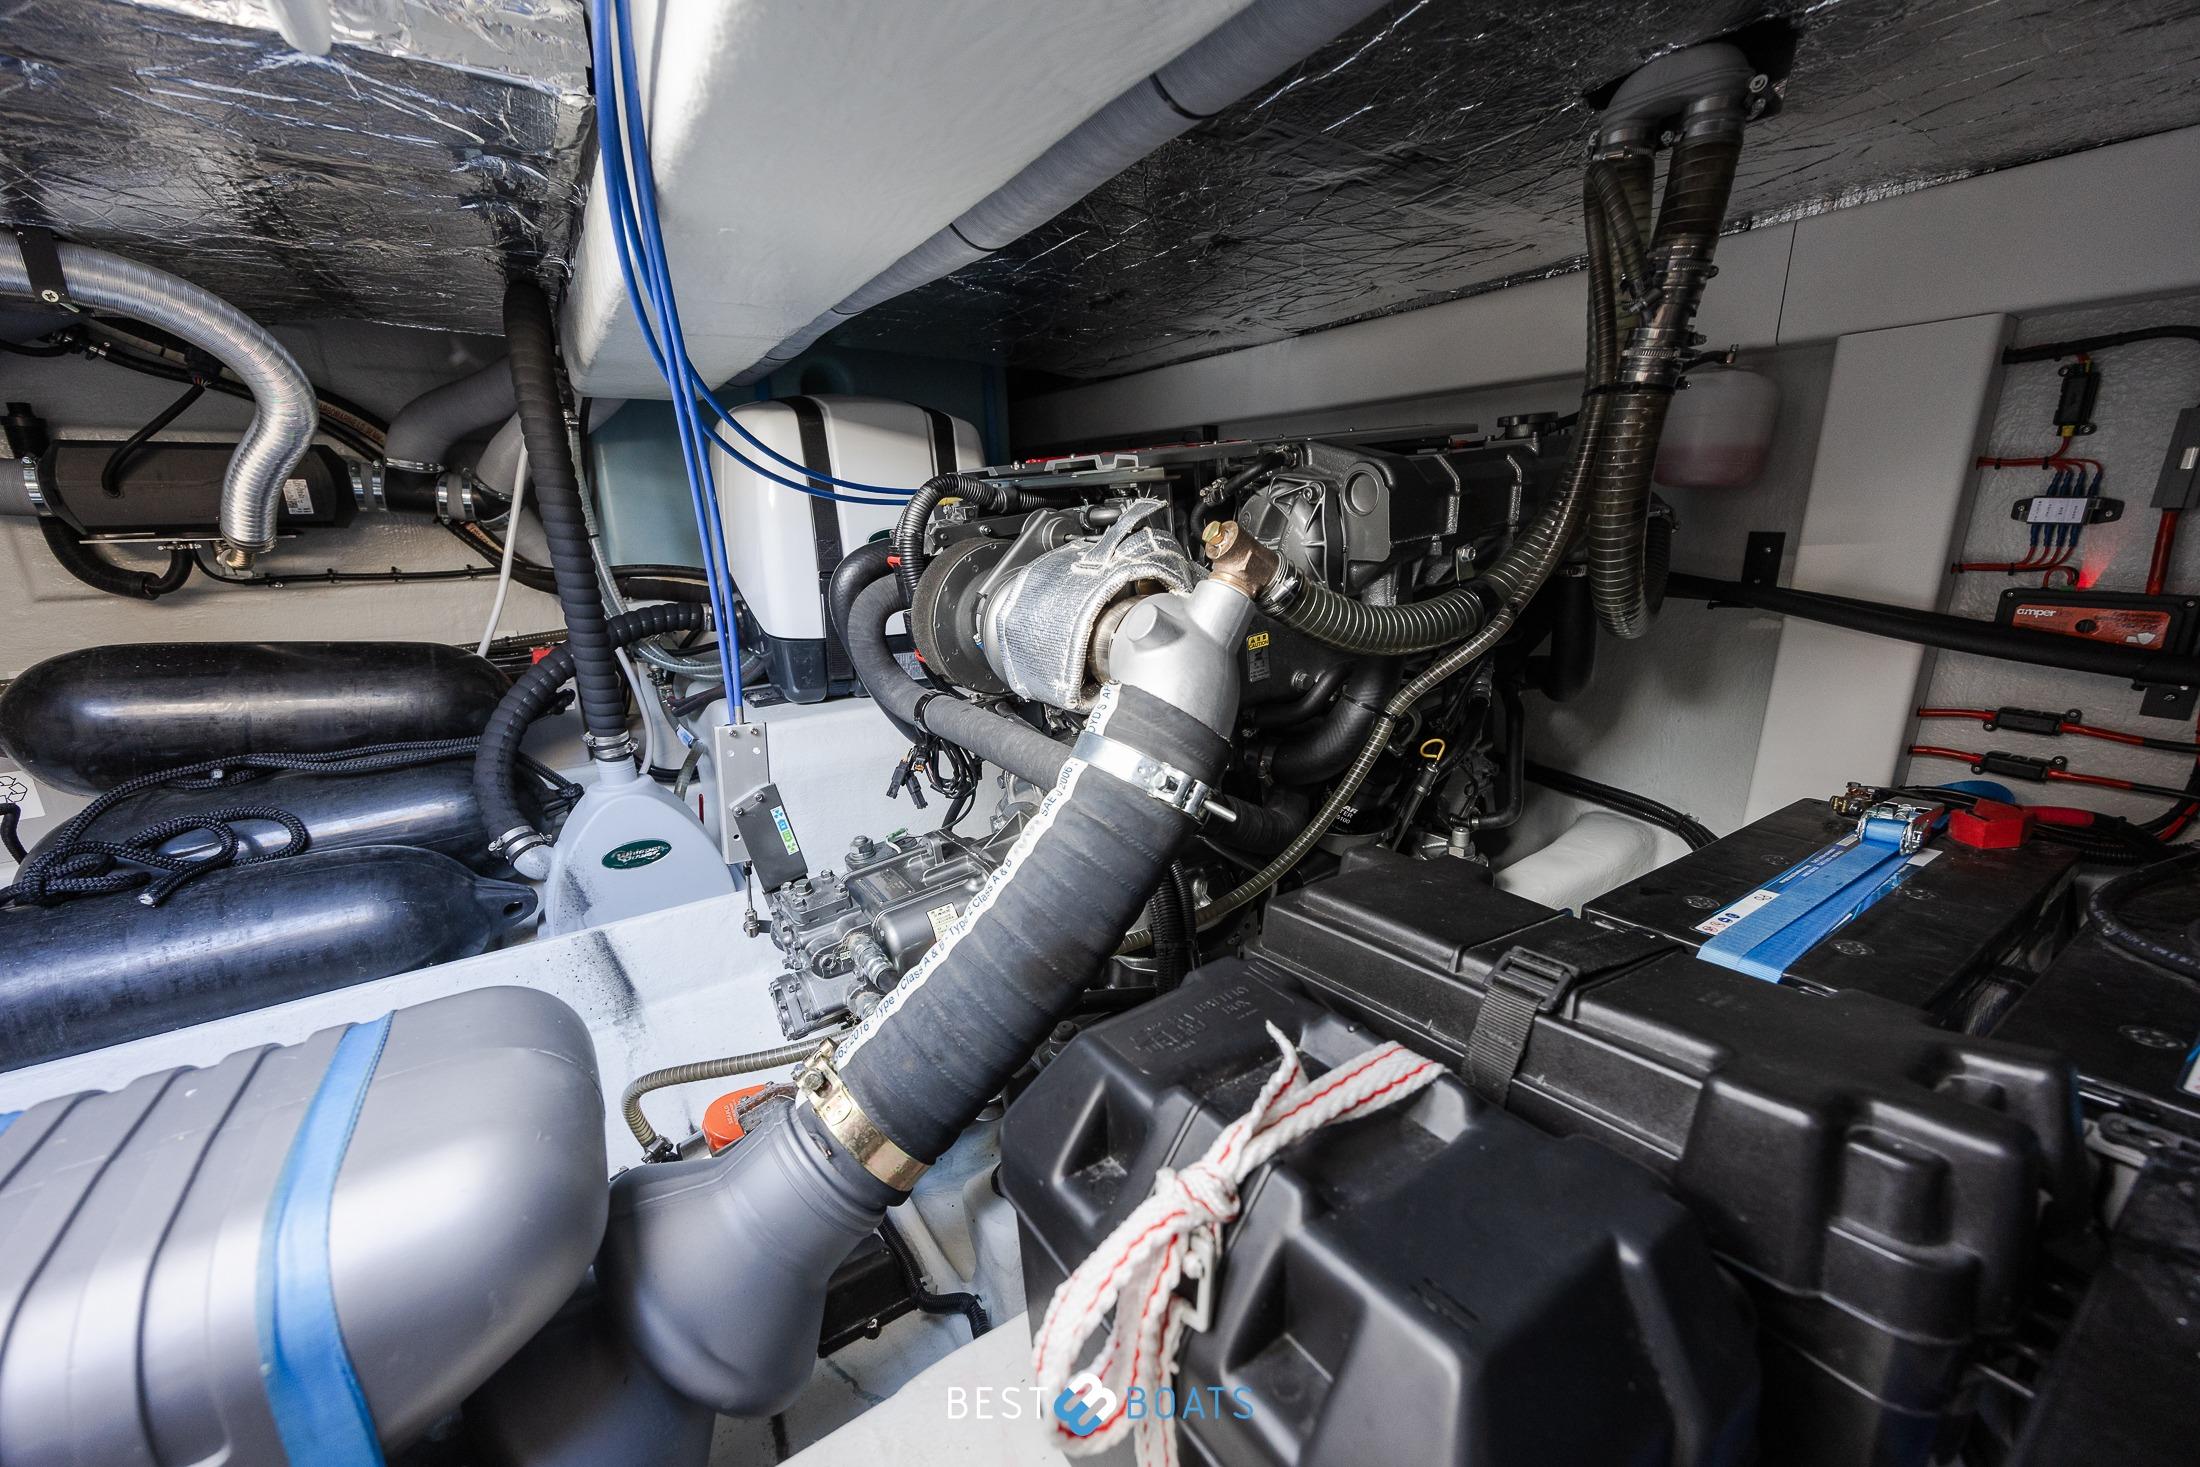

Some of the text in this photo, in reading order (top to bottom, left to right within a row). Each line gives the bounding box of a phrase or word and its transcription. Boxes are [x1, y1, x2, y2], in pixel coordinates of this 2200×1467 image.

[900, 967, 923, 990] Class
[972, 885, 993, 907] Class
[992, 875, 1000, 885] A
[1041, 796, 1057, 817] SAE
[1059, 766, 1073, 790] 2006
